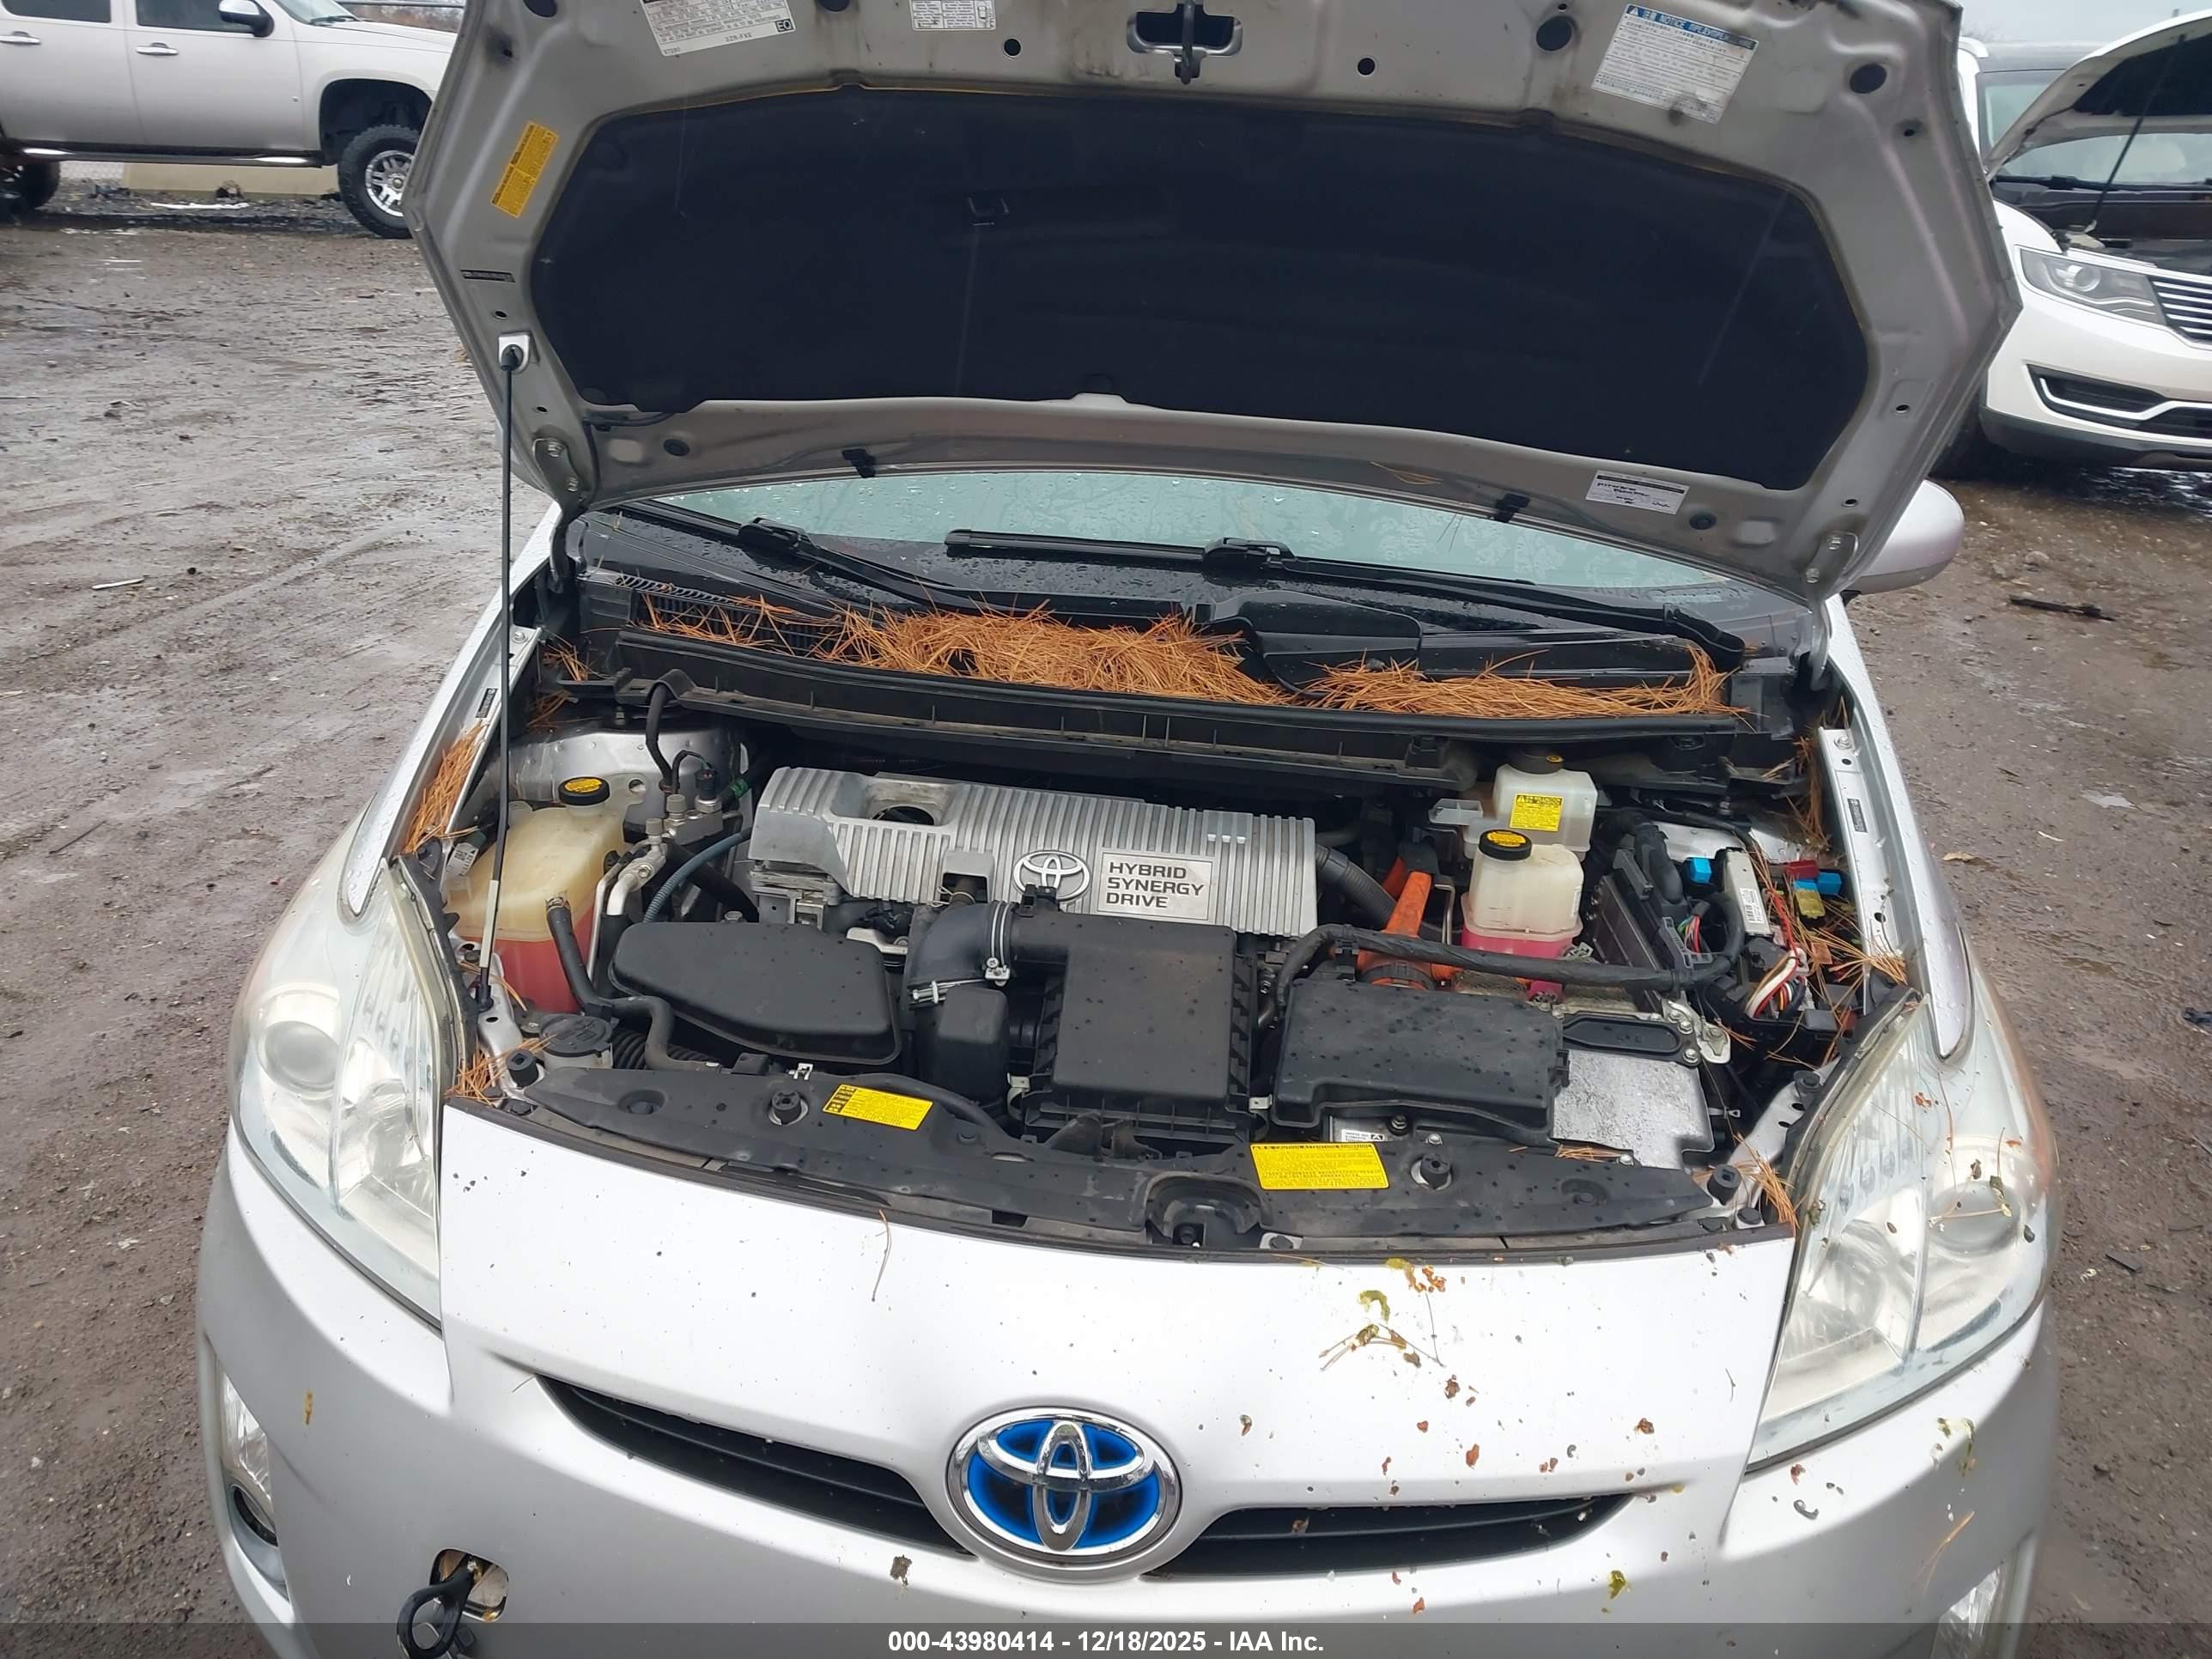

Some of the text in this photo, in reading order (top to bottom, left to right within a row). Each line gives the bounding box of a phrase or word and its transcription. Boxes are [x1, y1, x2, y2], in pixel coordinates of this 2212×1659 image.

[1109, 862, 1186, 878] HYBRID
[1108, 878, 1204, 896] SYNERGY
[1107, 893, 1168, 908] DRIVE
